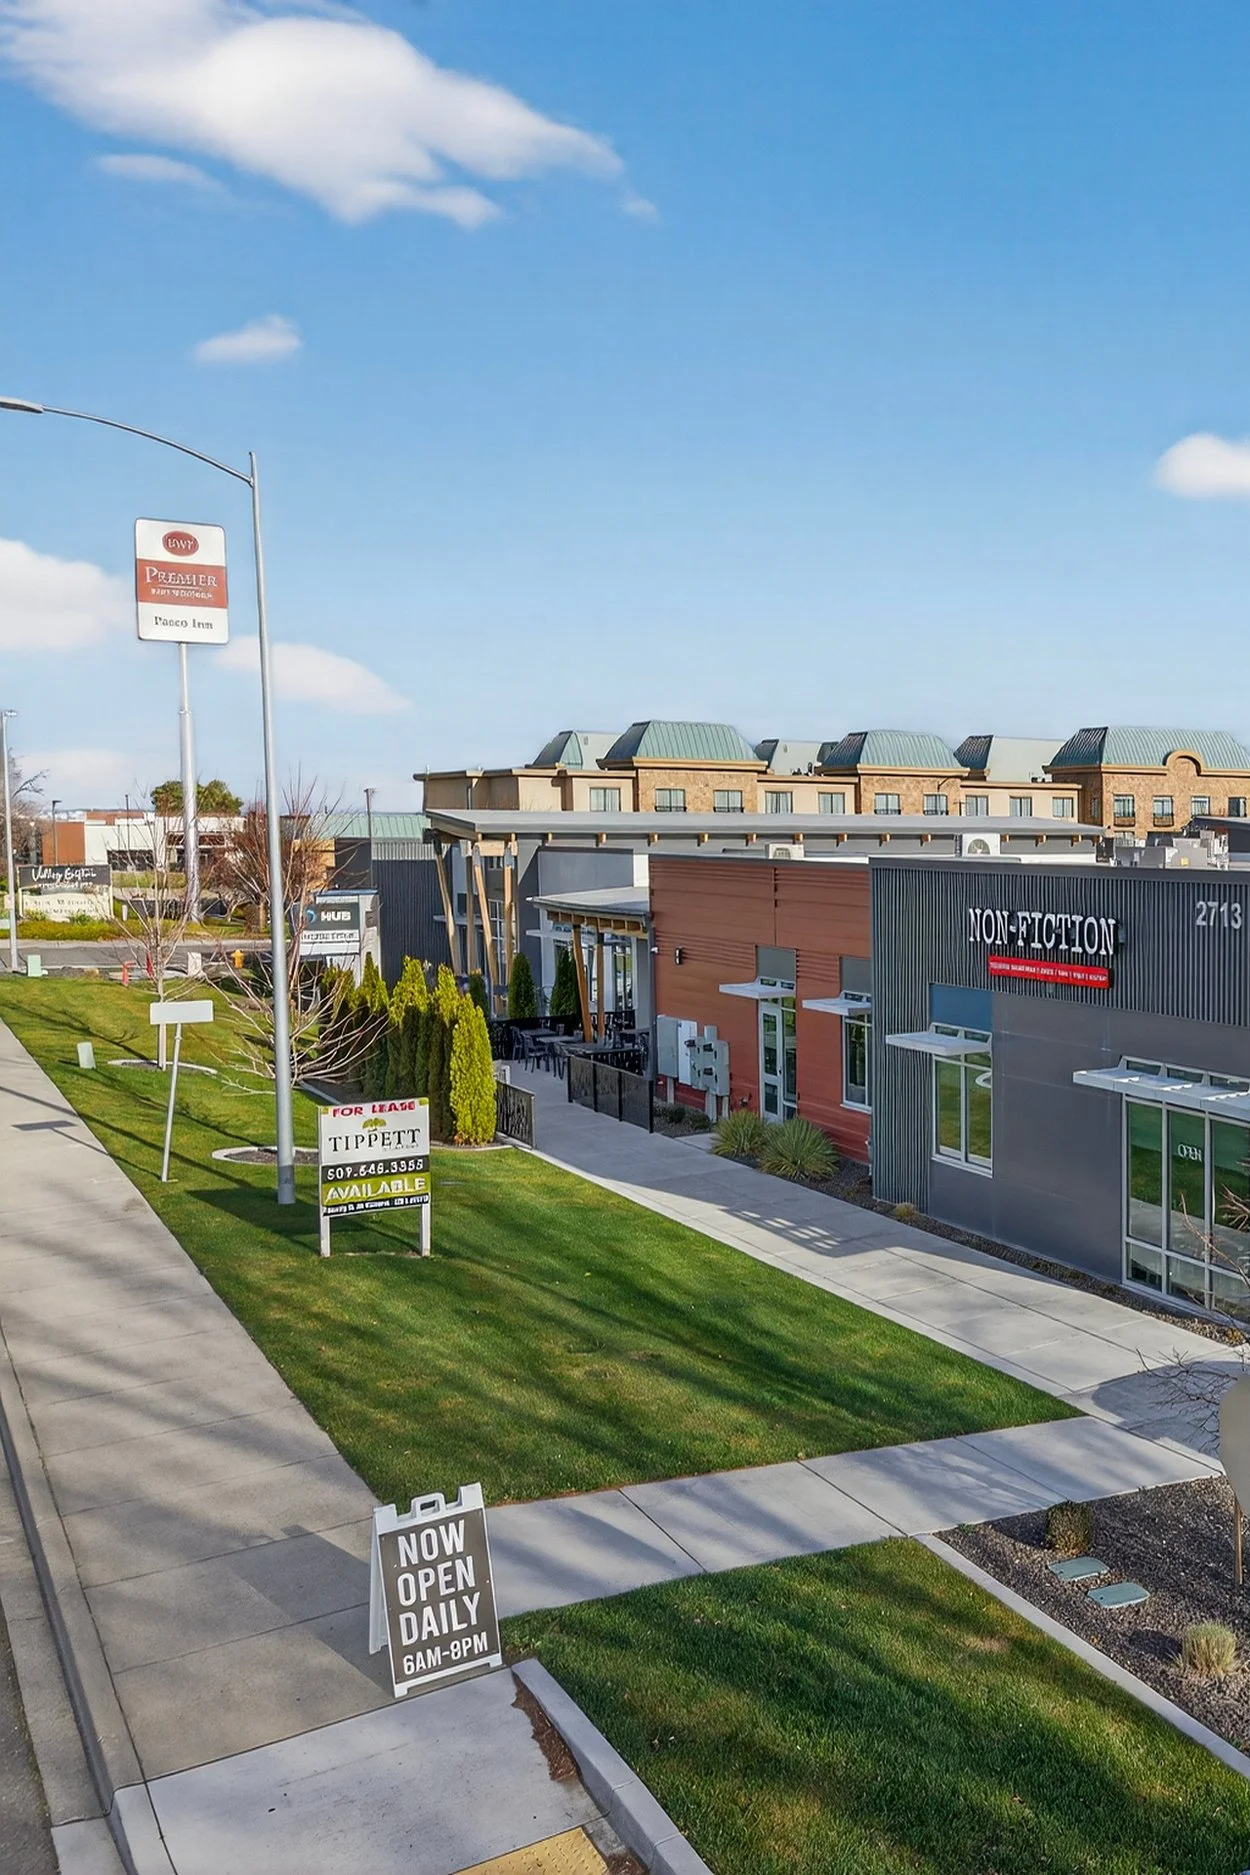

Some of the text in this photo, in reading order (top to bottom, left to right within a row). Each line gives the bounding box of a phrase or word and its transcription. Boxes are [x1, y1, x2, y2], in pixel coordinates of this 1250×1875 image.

[192, 618, 214, 630] Inn
[320, 911, 352, 922] HUB
[1195, 901, 1243, 930] 2713
[968, 907, 1117, 955] NON-FICTION
[332, 1101, 416, 1118] FOR LEASE
[328, 1128, 420, 1152] TIPPETT
[325, 1177, 427, 1203] AVAILABLE
[397, 1519, 466, 1568] NOW
[396, 1555, 476, 1607] OPEN
[398, 1591, 481, 1647] DAILY
[402, 1631, 489, 1676] 6AM-8PM
